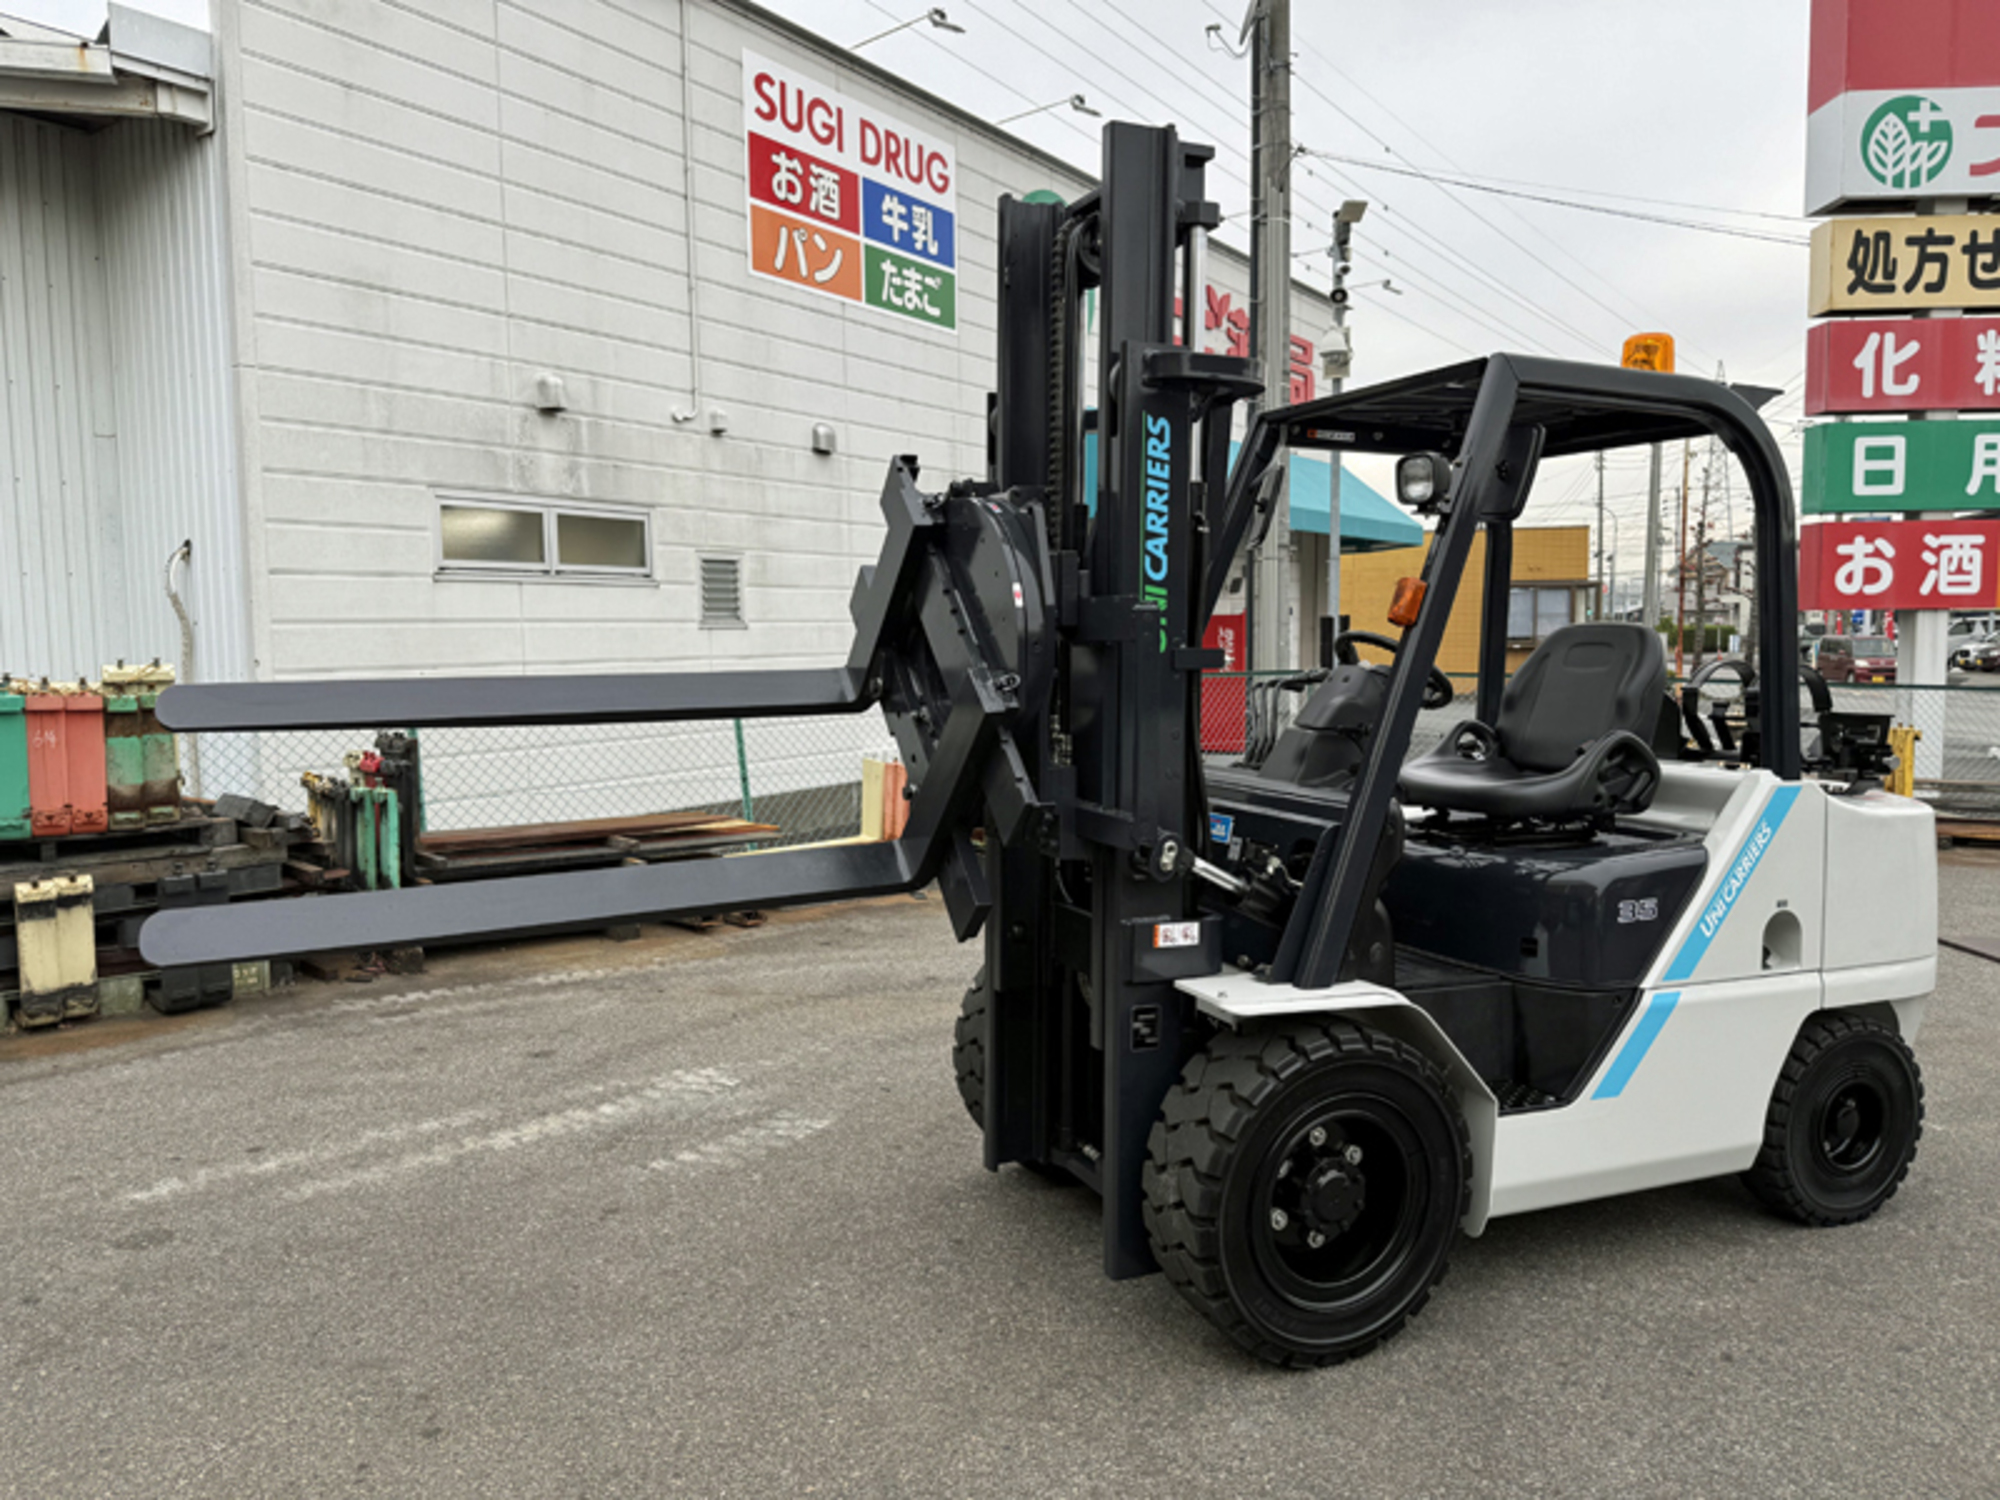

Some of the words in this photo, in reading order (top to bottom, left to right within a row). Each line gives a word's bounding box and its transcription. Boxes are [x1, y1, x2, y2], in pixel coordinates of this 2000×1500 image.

[753, 72, 844, 154] SUGI
[859, 117, 950, 195] DRUG
[771, 151, 841, 221] お酒
[774, 226, 842, 283] パン
[881, 193, 938, 257] 牛乳
[880, 259, 942, 317] たまご
[1834, 534, 1986, 596] お酒
